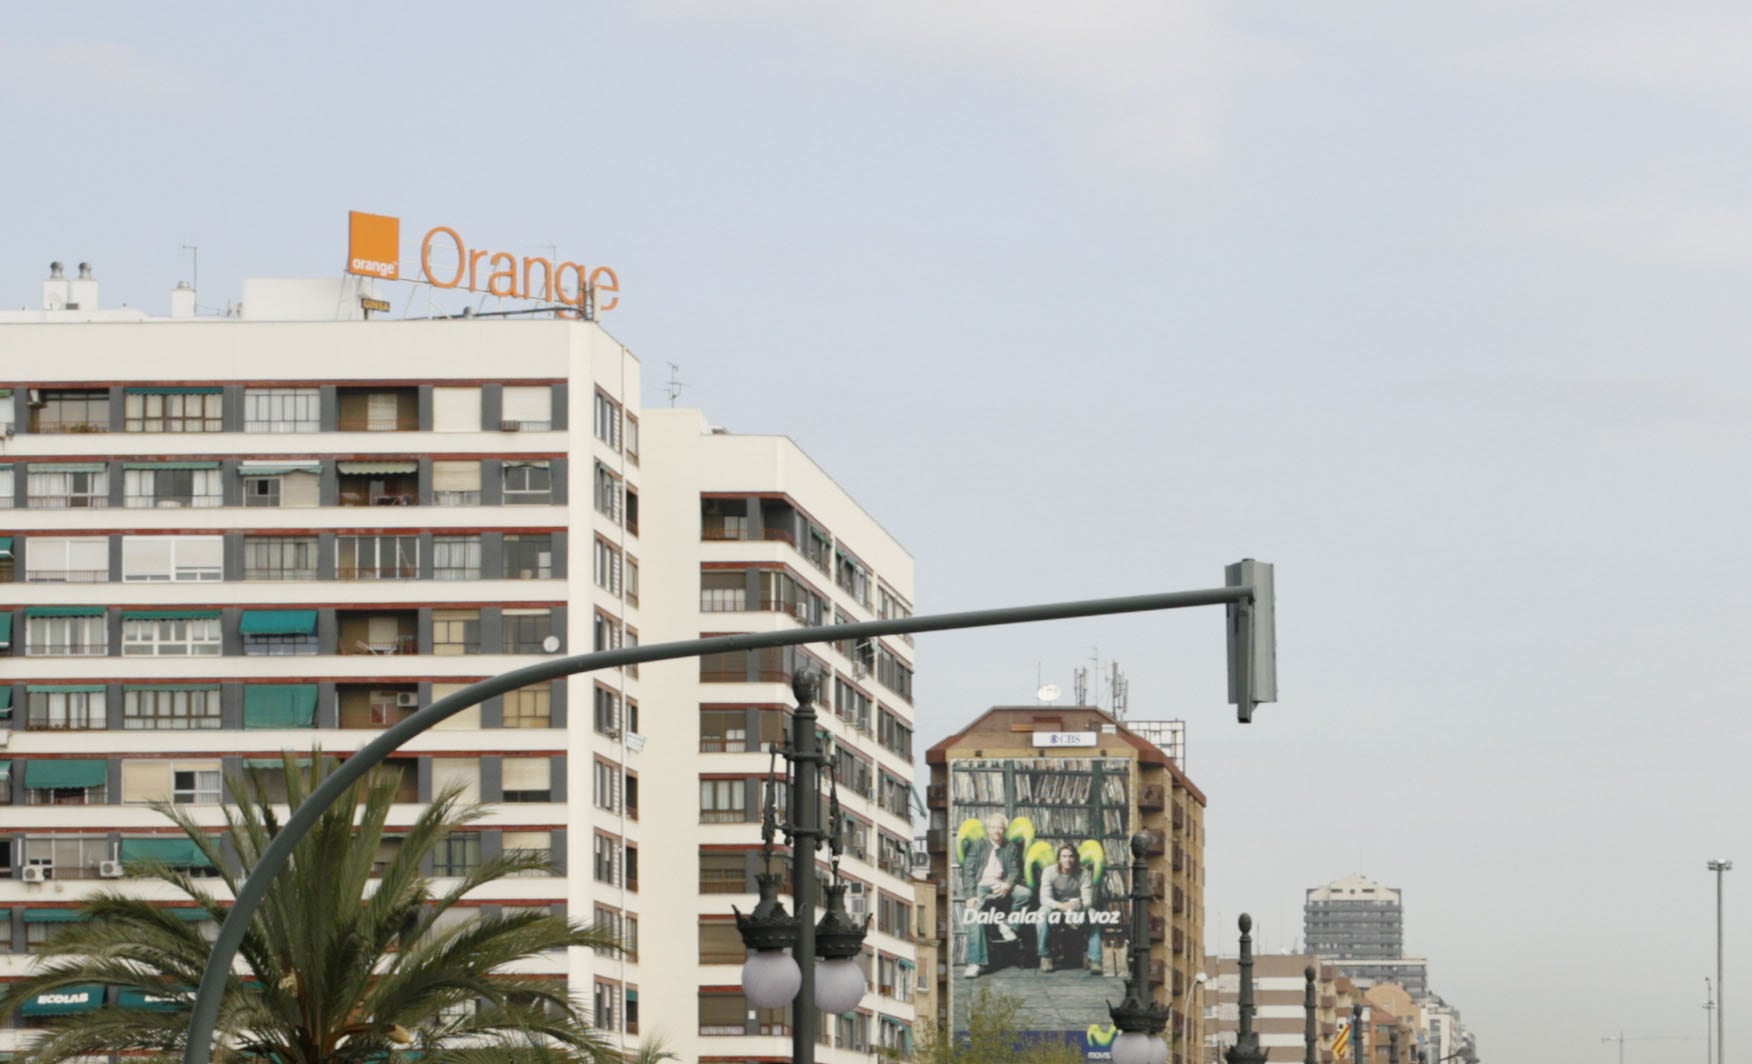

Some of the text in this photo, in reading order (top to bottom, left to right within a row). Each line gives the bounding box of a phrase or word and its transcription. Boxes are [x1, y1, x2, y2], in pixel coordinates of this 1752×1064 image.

[353, 258, 395, 277] orange
[421, 226, 620, 320] Orange
[963, 906, 1121, 925] Dale alas a tu voz
[37, 992, 89, 1005] ECOLAB
